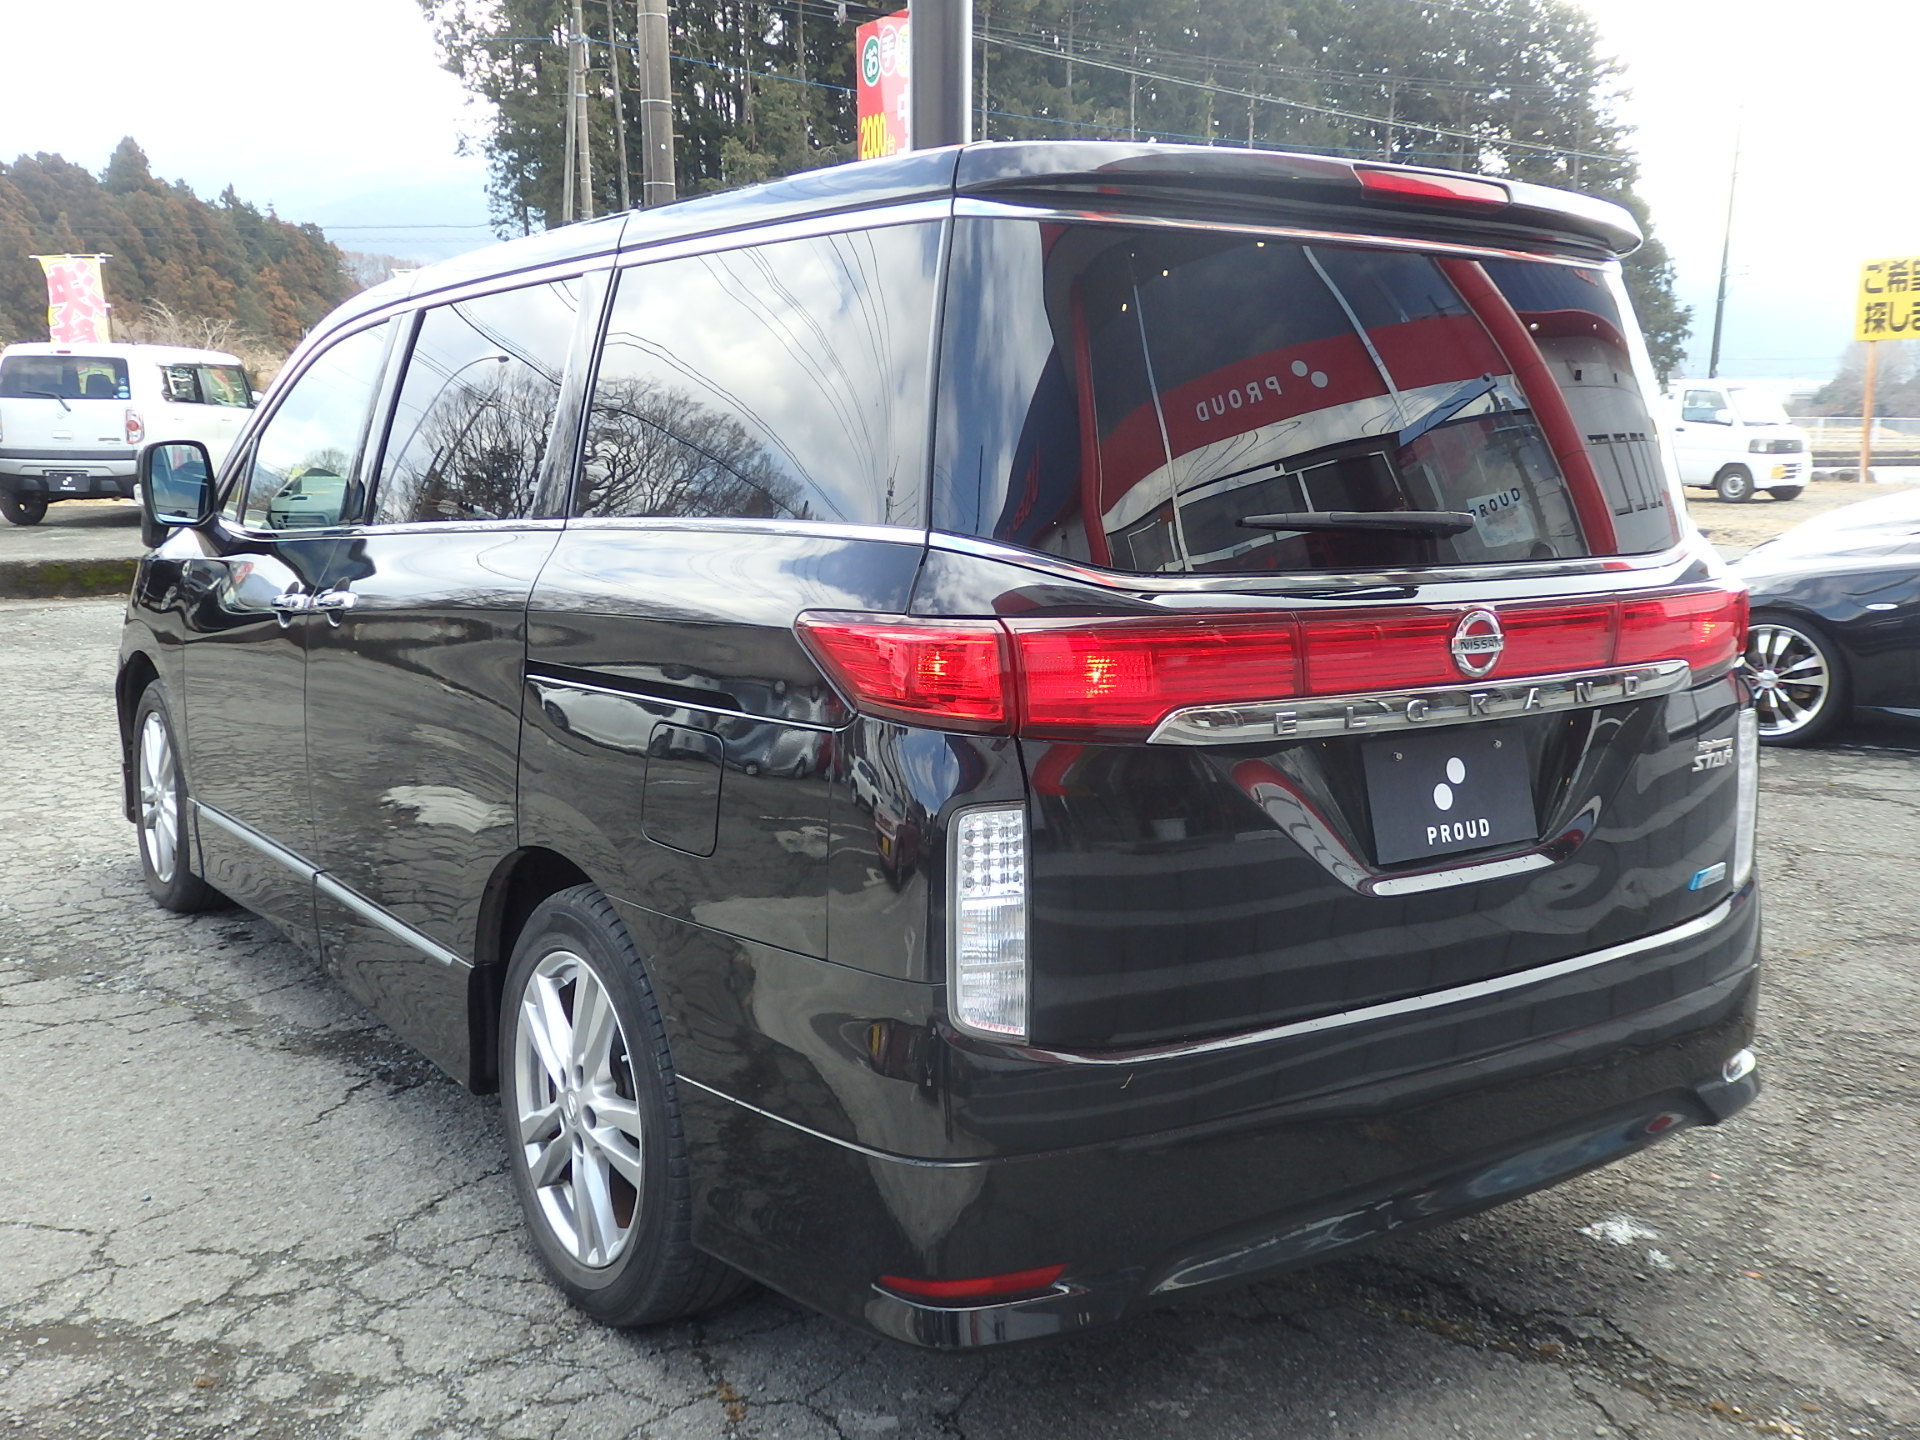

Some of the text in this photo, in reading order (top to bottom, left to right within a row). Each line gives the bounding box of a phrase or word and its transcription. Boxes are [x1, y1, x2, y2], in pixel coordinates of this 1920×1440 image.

[1460, 638, 1502, 651] NISSAN
[1274, 676, 1640, 737] ELGRAND
[1691, 748, 1734, 773] STAR
[1426, 818, 1491, 846] PROUD
